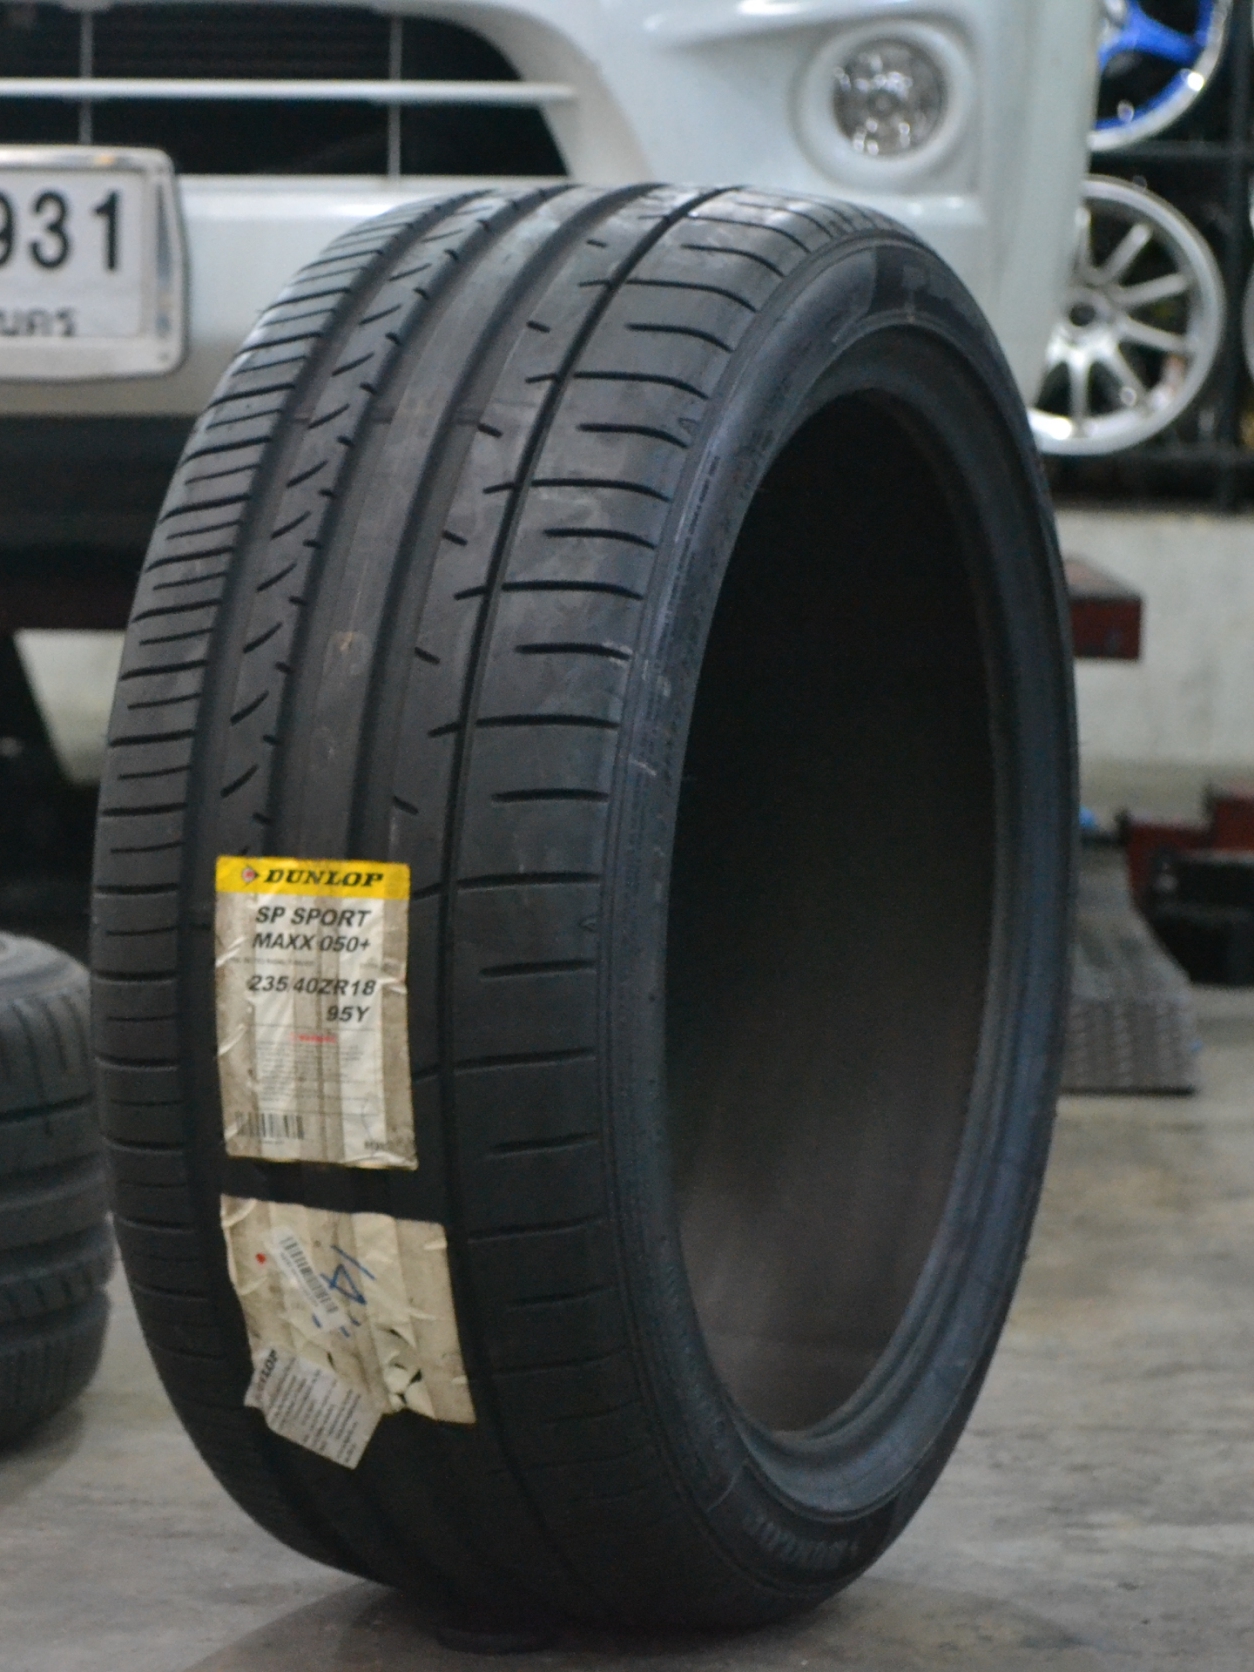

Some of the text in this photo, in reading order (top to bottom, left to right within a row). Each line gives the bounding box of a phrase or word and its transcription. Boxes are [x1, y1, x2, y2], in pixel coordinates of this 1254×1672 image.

[263, 868, 384, 888] DUNLOP
[255, 906, 372, 927] SP SPORT
[252, 933, 372, 953] MAXX 050+
[326, 1006, 370, 1023] 95Y
